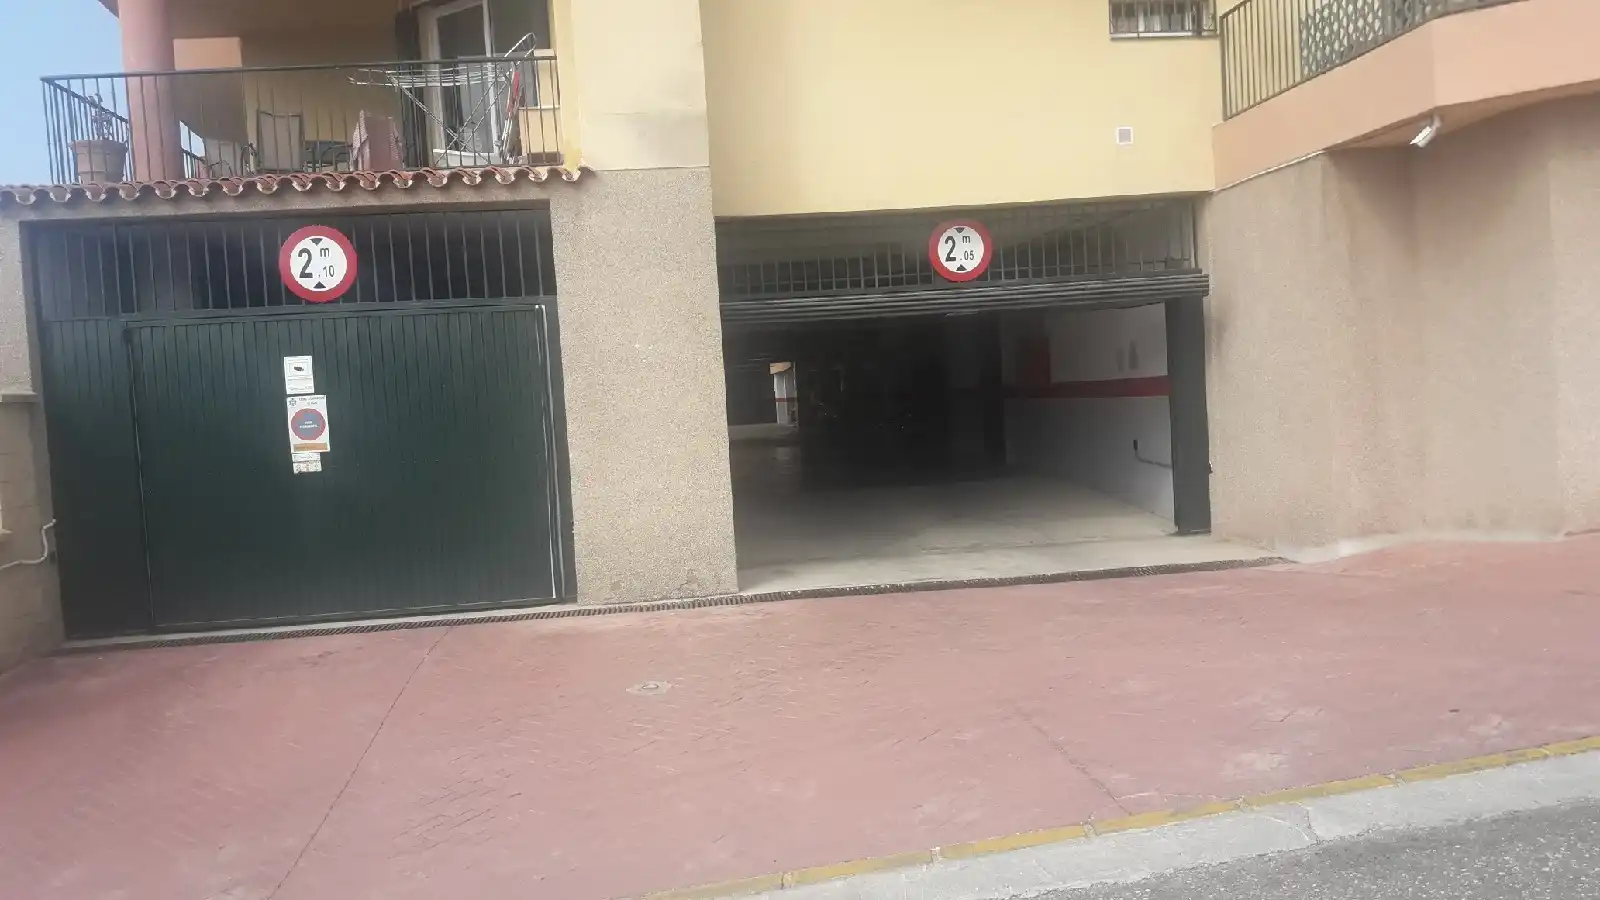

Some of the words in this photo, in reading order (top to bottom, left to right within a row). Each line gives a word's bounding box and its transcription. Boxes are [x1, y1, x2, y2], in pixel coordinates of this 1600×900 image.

[298, 247, 313, 278] 2
[319, 247, 330, 257] m
[944, 235, 957, 262] 2
[962, 235, 971, 244] m
